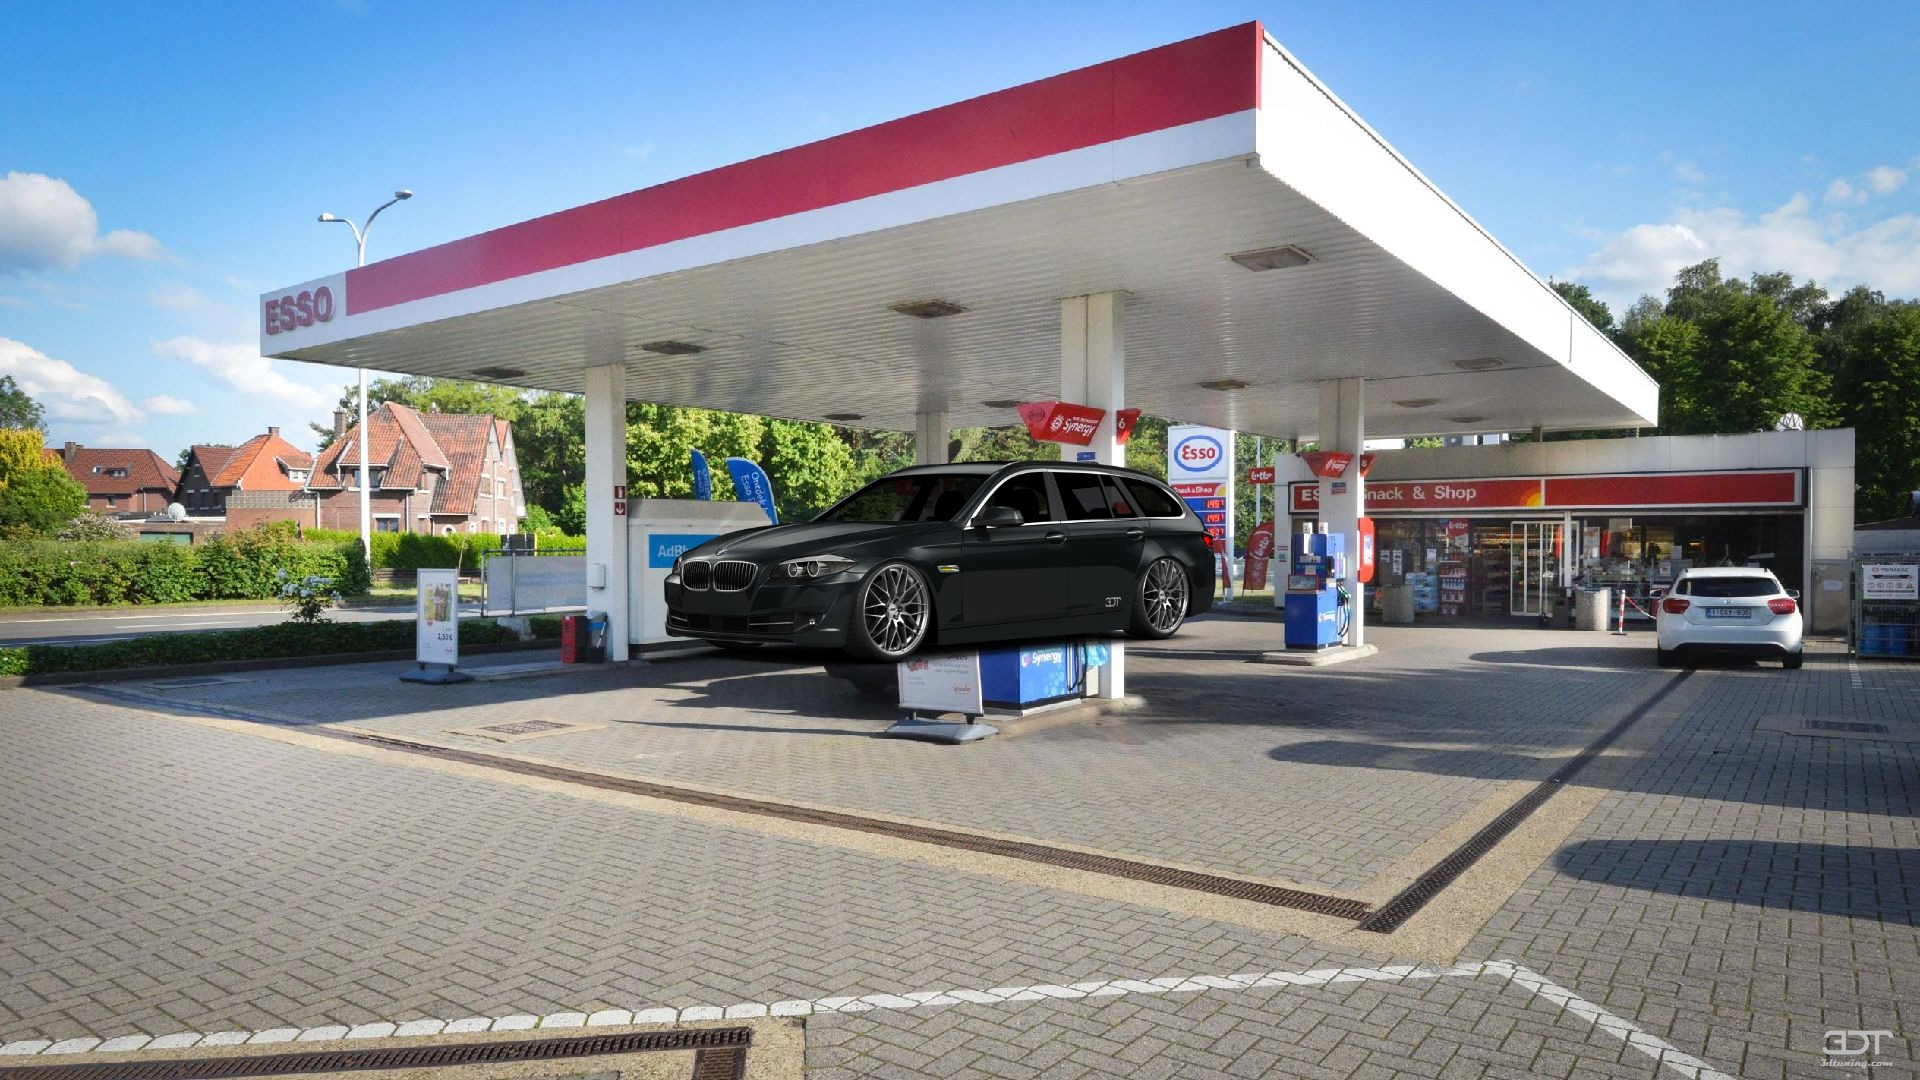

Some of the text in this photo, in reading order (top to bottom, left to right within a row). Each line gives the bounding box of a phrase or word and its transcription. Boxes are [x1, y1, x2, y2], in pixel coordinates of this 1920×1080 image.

[265, 286, 335, 335] ESSO
[1063, 418, 1095, 436] Synergy
[1118, 418, 1125, 429] 6
[1182, 445, 1215, 460] Esso
[742, 474, 751, 495] Esso
[1196, 487, 1213, 495] Shop
[1301, 489, 1320, 501] ES
[1412, 486, 1425, 500] &
[1434, 485, 1477, 502] Shop
[658, 544, 688, 557] AdBl
[1105, 597, 1121, 607] 3DT
[1032, 652, 1062, 666] Synergy
